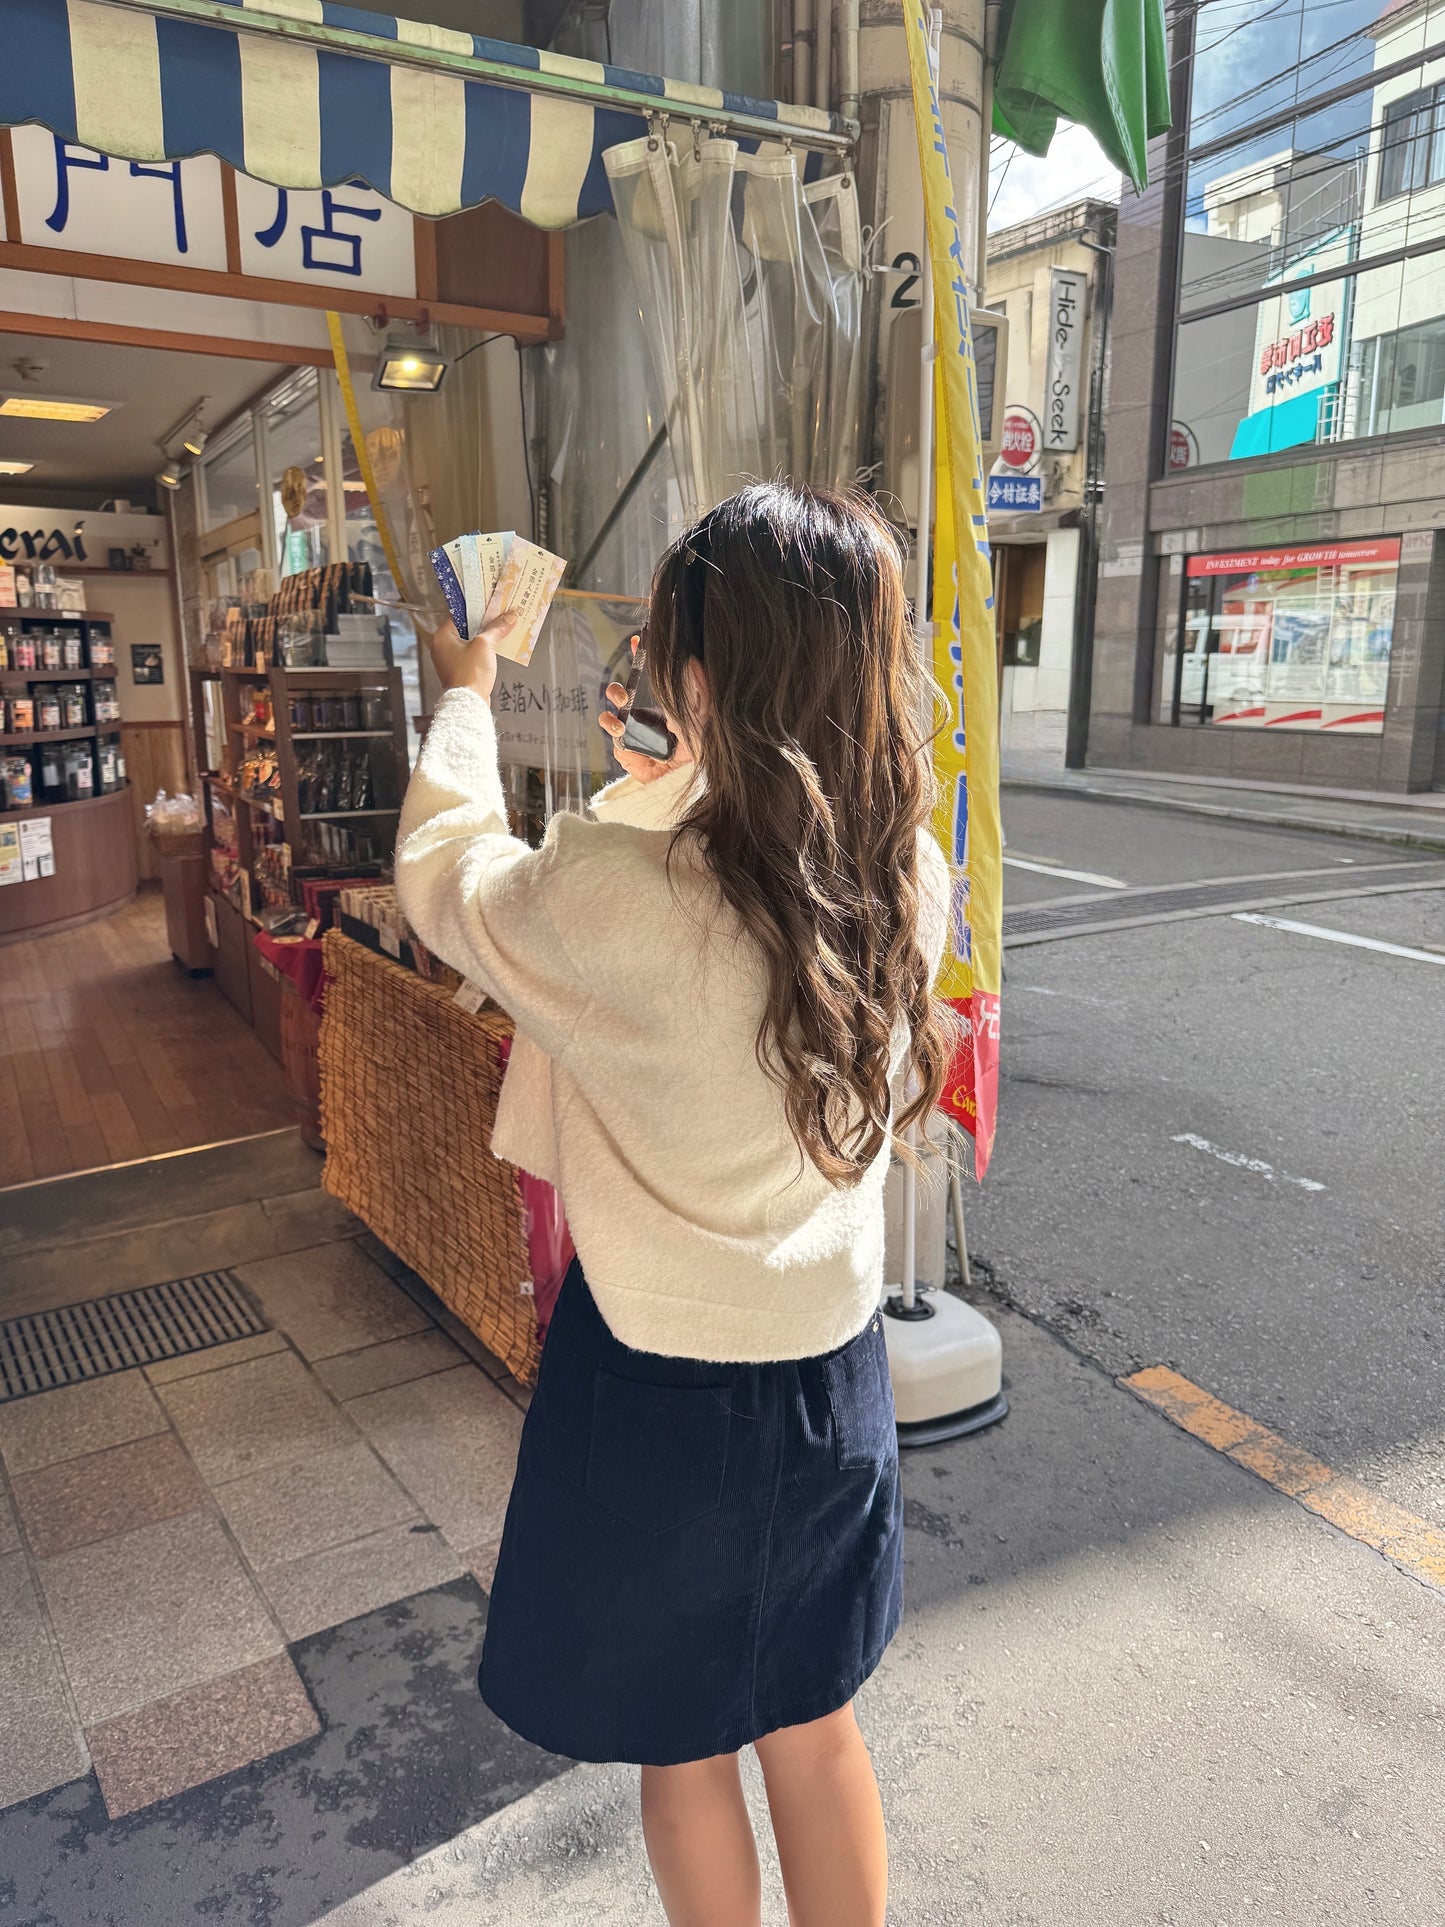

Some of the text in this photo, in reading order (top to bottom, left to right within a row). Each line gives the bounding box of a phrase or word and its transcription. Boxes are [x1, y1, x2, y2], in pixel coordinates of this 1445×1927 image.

[890, 252, 921, 309] 2
[1003, 431, 1032, 453] 消火栓
[989, 481, 1040, 505] 今村証券
[1205, 548, 1379, 570] INVESTMENT today for GROWTH tomorrow
[497, 681, 589, 717] 金箔入り珈琲
